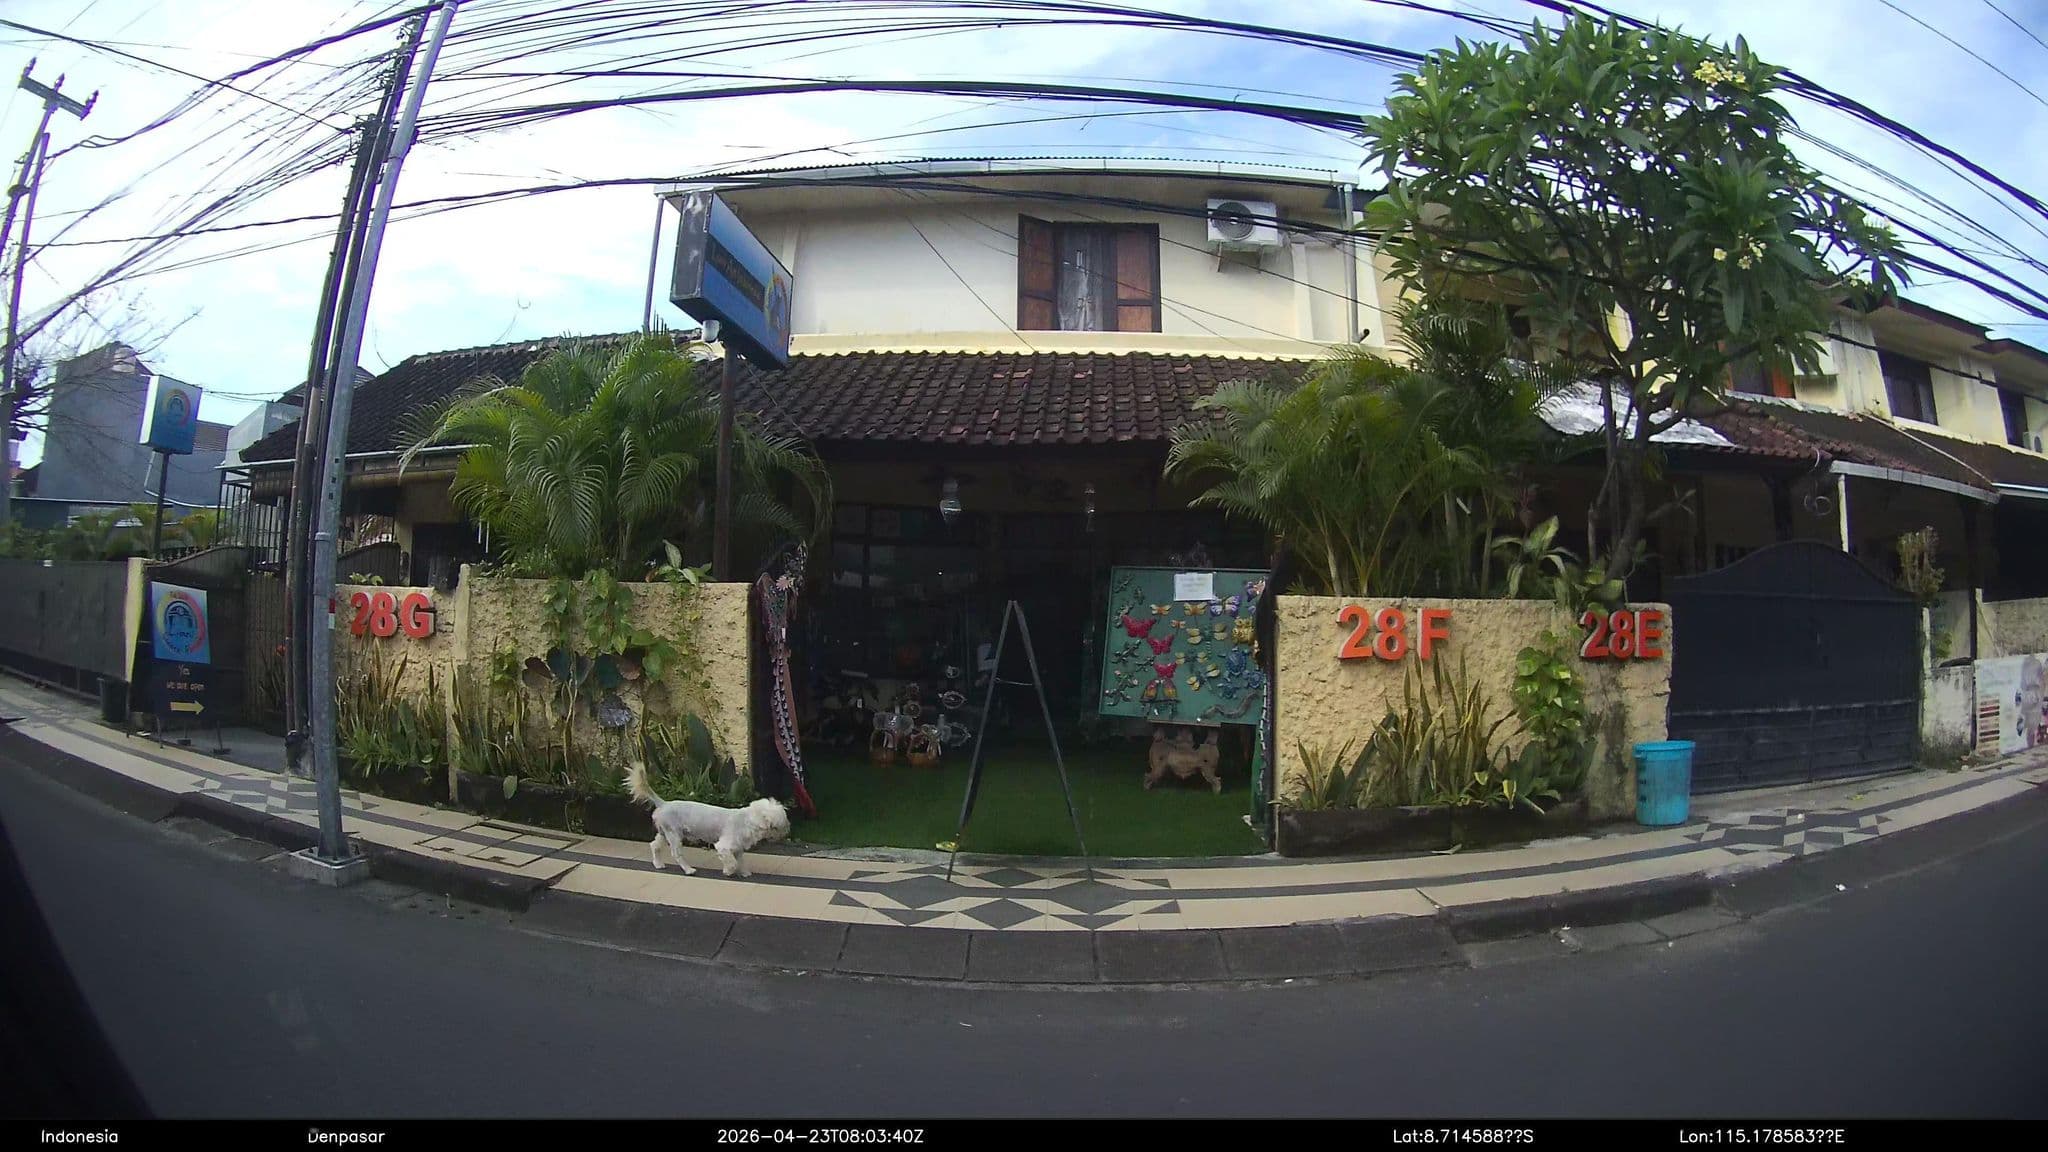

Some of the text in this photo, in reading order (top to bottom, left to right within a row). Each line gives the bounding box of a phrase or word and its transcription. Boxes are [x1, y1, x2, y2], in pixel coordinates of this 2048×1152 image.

[351, 591, 434, 639] 28G
[1337, 605, 1452, 661] 28F
[1580, 609, 1664, 659] 28E
